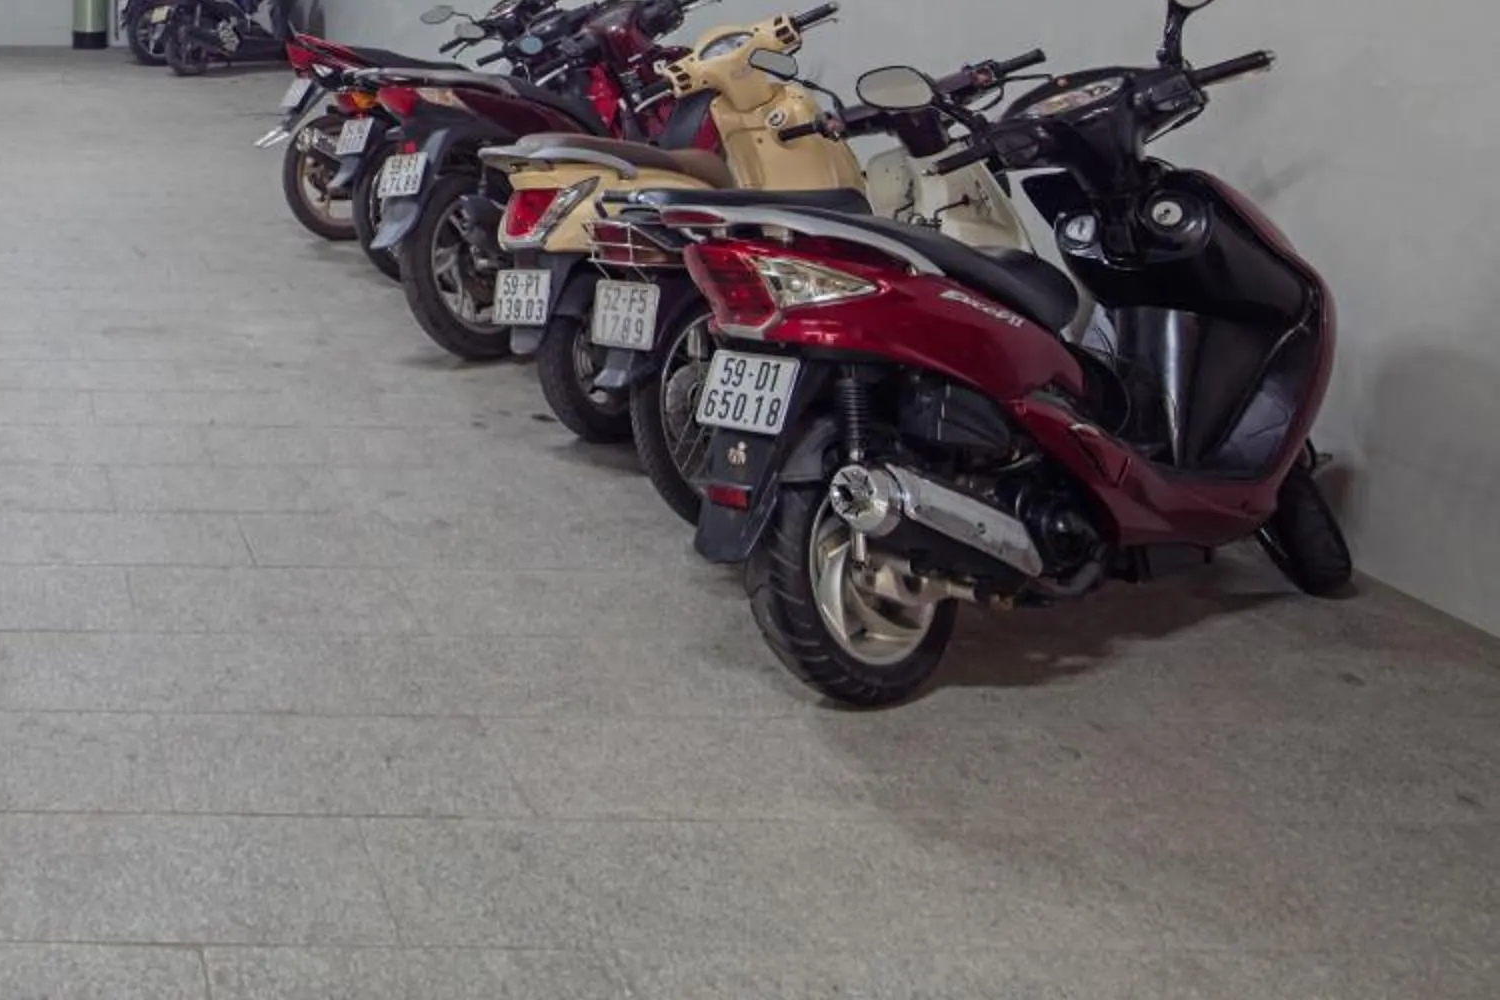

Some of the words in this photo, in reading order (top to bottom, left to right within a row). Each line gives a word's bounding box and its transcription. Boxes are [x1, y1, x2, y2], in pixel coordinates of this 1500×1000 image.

[503, 273, 542, 296] 59-P1
[602, 286, 649, 314] 52-F5
[601, 313, 645, 343] 1789
[720, 357, 781, 392] 59-D1
[703, 389, 782, 427] 650.18
